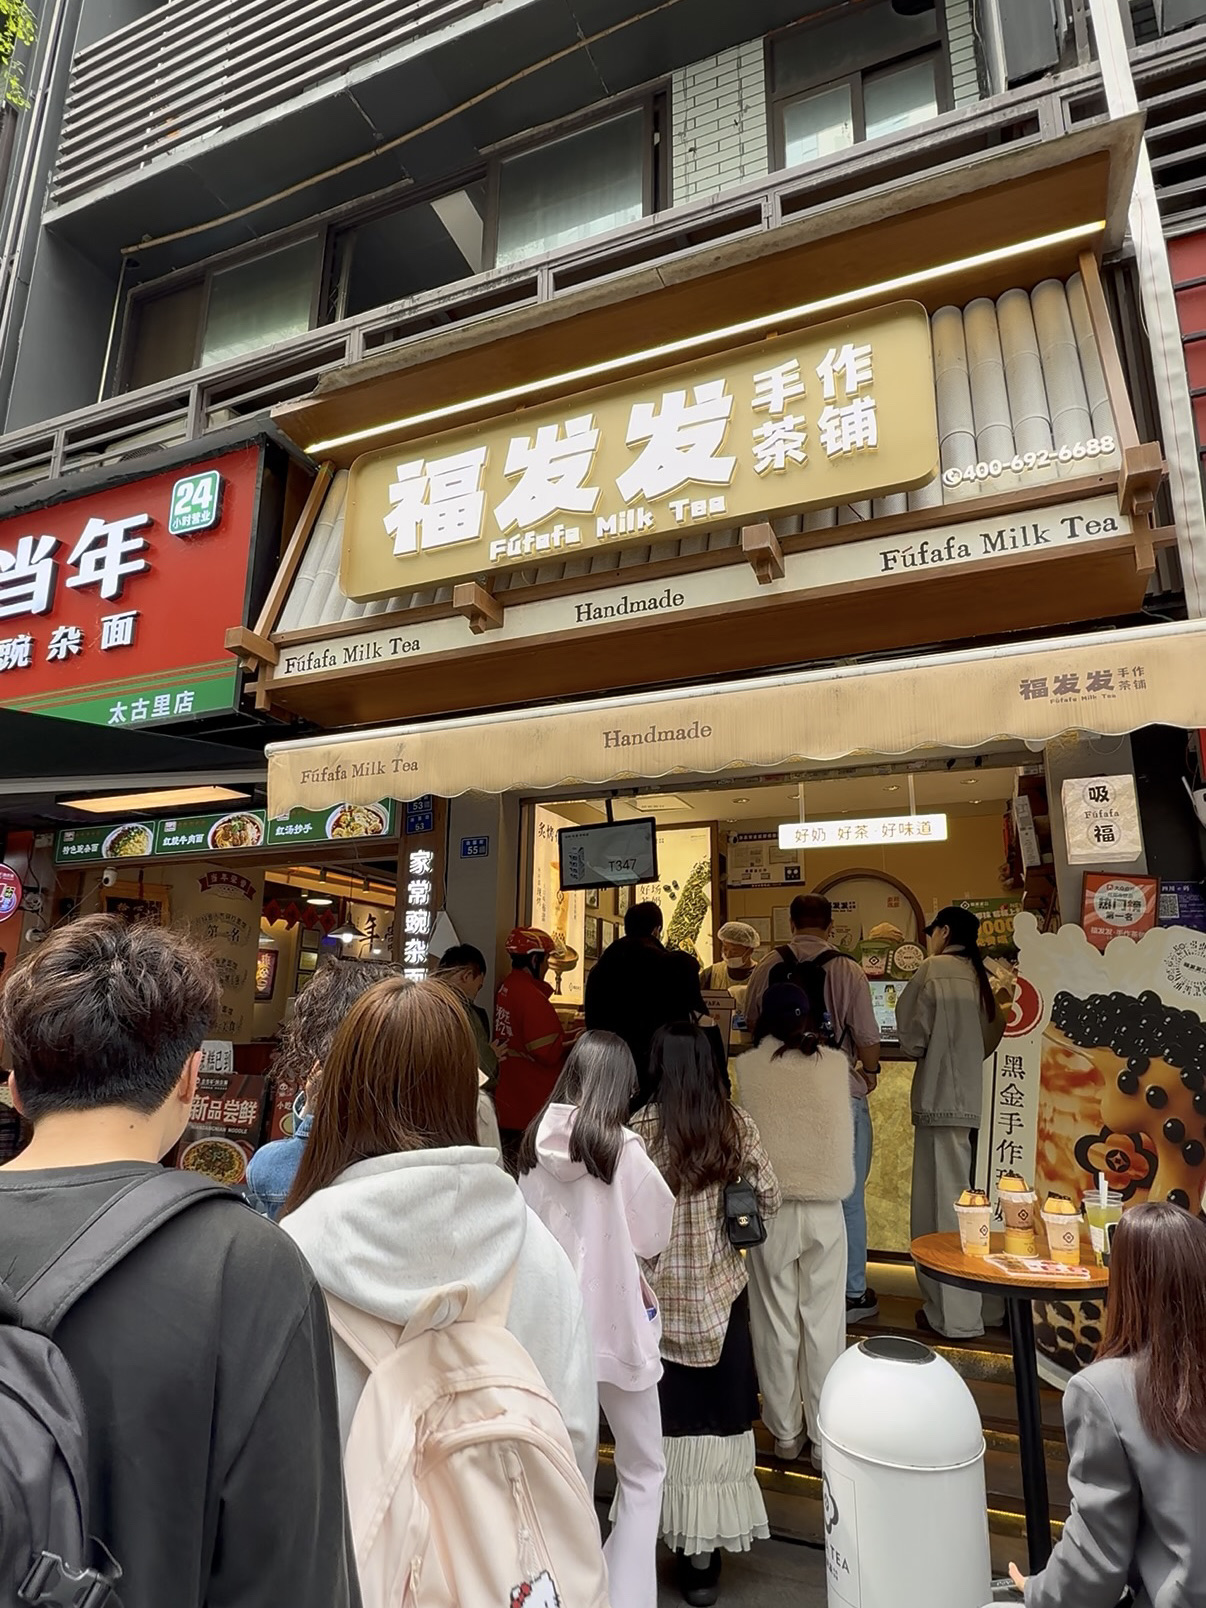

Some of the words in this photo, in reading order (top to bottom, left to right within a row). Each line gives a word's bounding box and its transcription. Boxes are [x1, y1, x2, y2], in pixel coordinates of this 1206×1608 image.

[752, 343, 874, 417] 手作
[753, 398, 877, 475] 茶铺
[383, 379, 738, 558] 福发发
[963, 435, 1116, 482] 400-692-6688
[174, 477, 213, 515] 24
[172, 510, 210, 529] 小时营业
[489, 525, 582, 562] Fúfafa
[596, 511, 655, 540] Milk
[669, 496, 727, 523] Tea
[879, 536, 972, 572] Fúfafa
[979, 523, 1052, 554] Milk
[1060, 515, 1118, 539] Tea
[0, 513, 149, 617] 当年
[575, 589, 685, 623] Handmade
[285, 647, 337, 675] Fúfafa
[342, 640, 382, 664] Milk
[390, 636, 421, 656] Tea
[1019, 669, 1115, 701] 福发发
[1117, 666, 1145, 678] 手作
[1118, 679, 1147, 691] 茶铺
[108, 691, 195, 724] 太古里店
[603, 721, 712, 749] Handmade
[300, 763, 347, 785] Fúfafa
[352, 760, 386, 779] Milk
[392, 758, 419, 774] Tea
[412, 801, 424, 810] 53
[1089, 785, 1109, 803] 吸
[162, 833, 204, 846] 红烧牛肉面
[275, 823, 312, 836] 红汤抄手
[795, 827, 826, 843] 好奶
[837, 824, 869, 840] 好茶
[881, 821, 932, 839] 好味道
[1094, 825, 1115, 842] 福
[467, 845, 478, 855] 55
[608, 858, 637, 873] T347
[190, 1094, 257, 1124] 新品尝鲜
[830, 1543, 850, 1574] TEA
